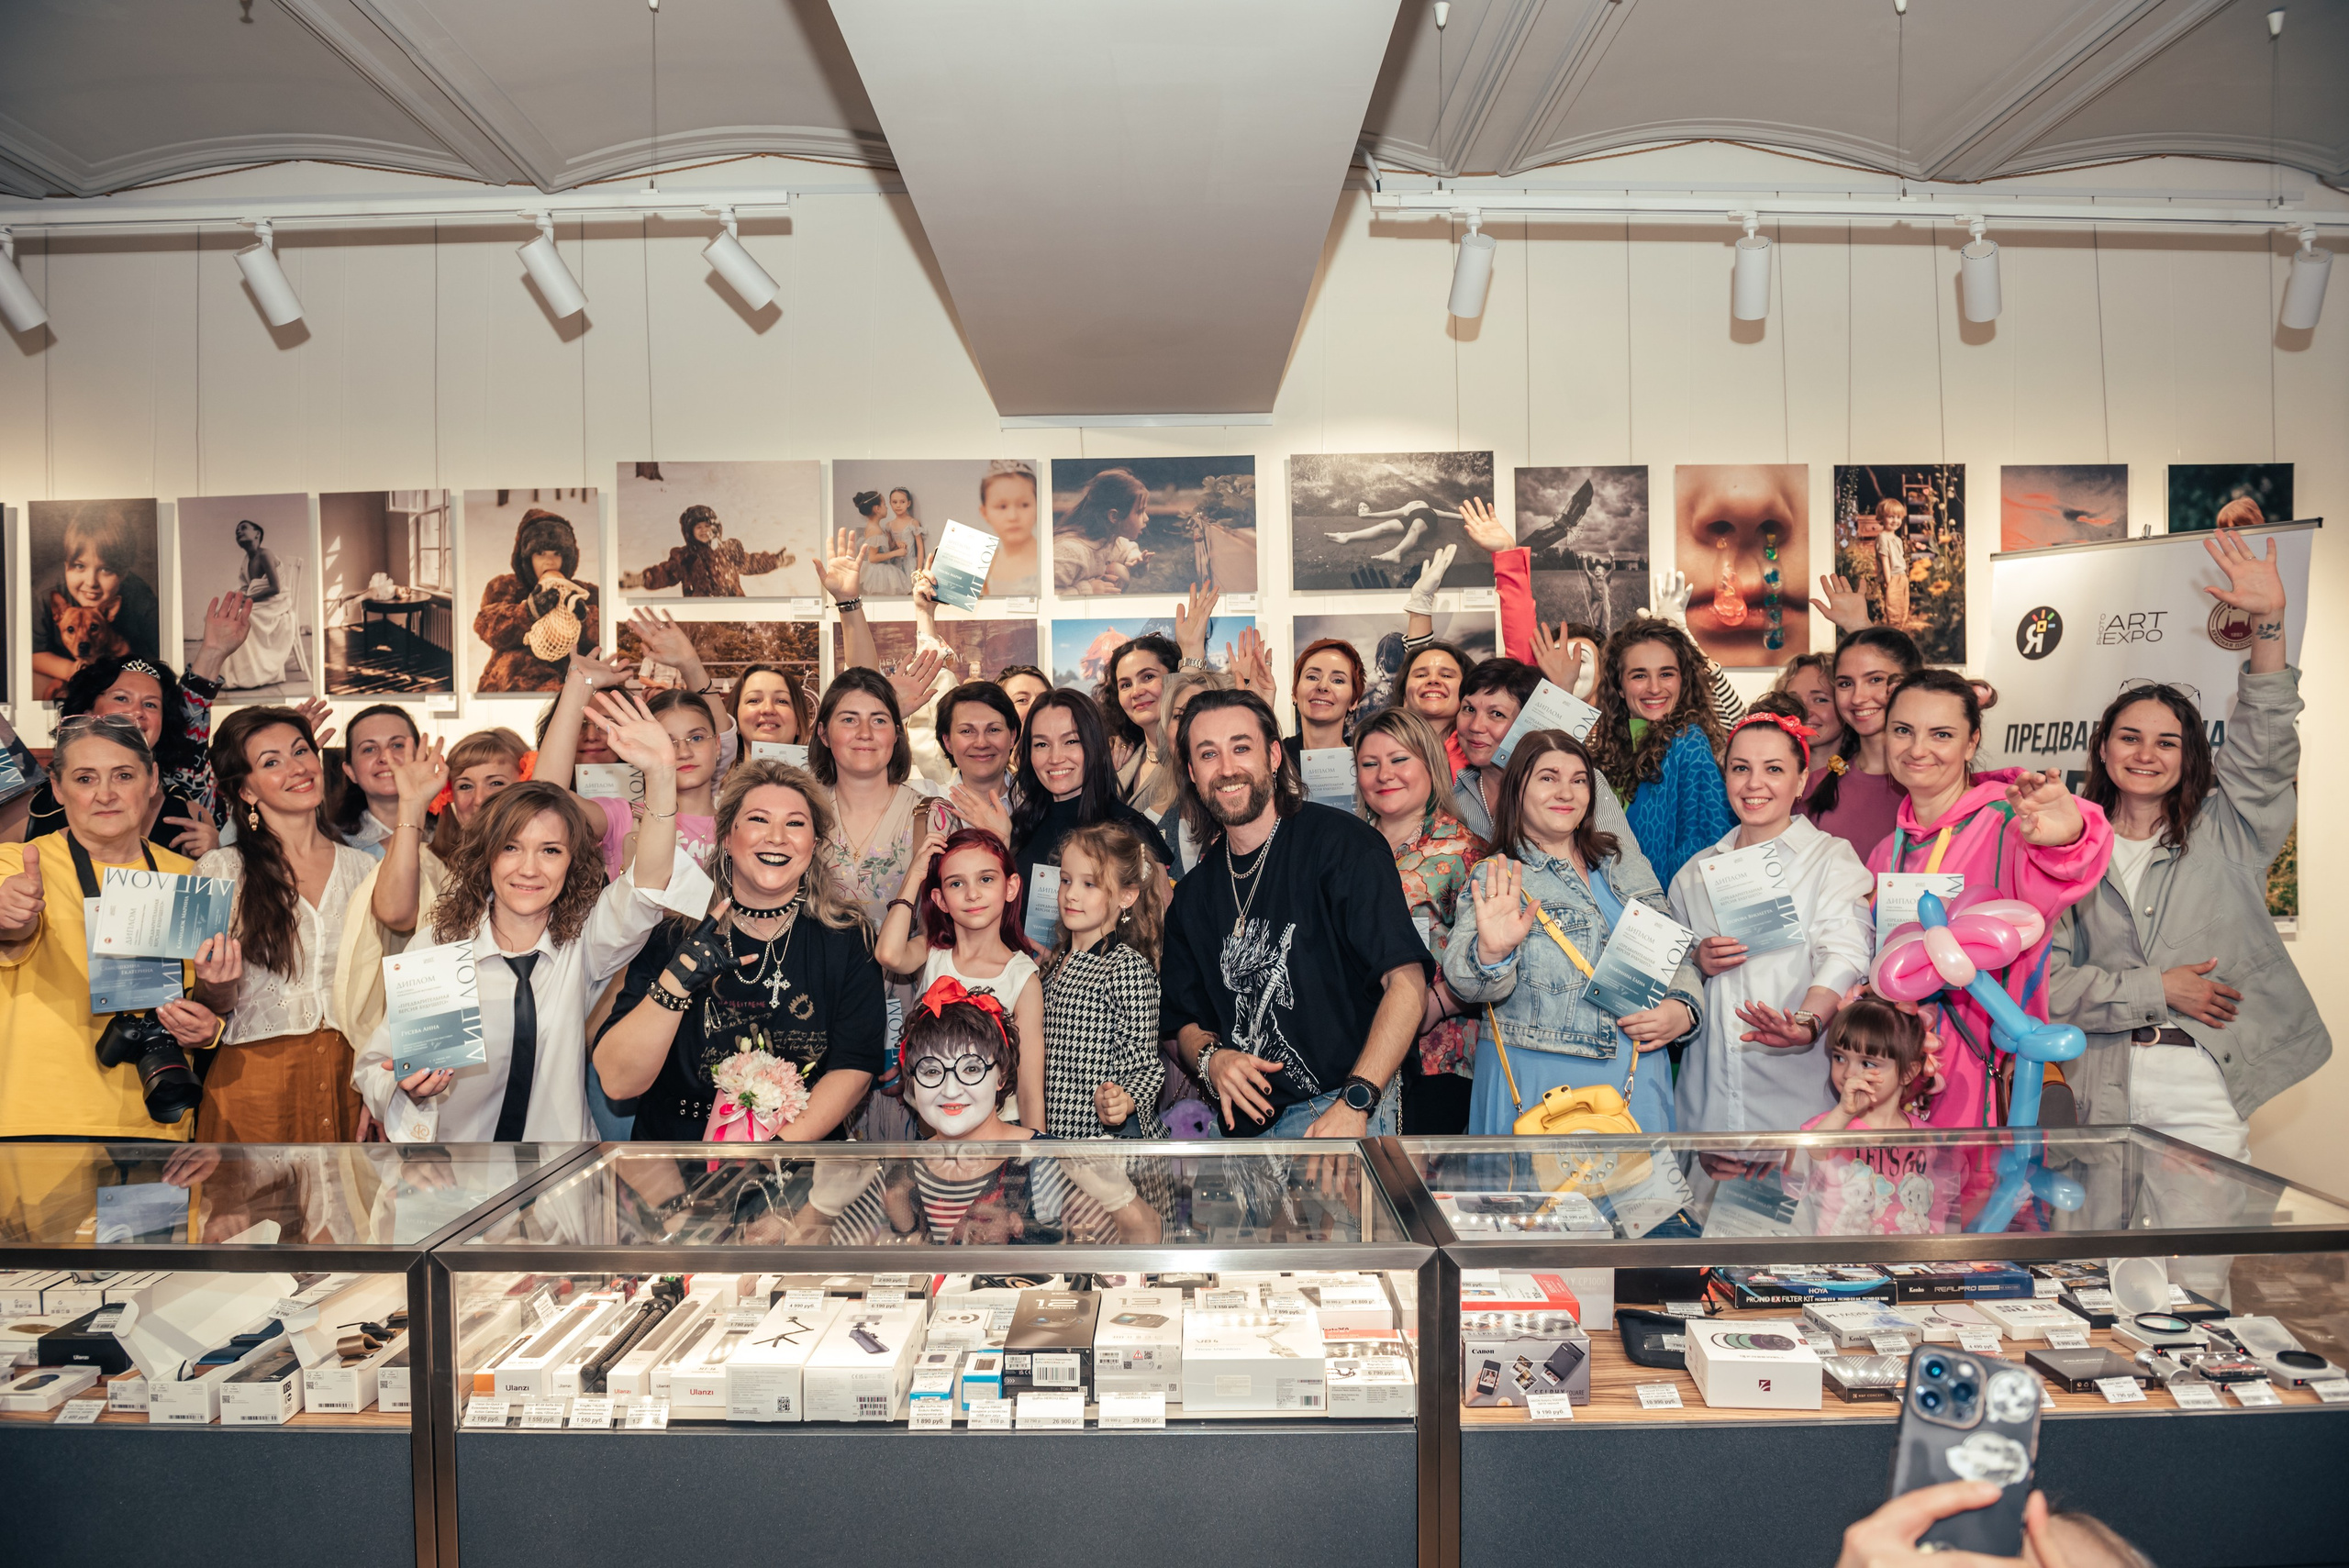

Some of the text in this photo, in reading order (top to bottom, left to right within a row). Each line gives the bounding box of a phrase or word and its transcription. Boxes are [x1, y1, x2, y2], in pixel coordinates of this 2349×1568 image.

[2106, 611, 2168, 631] ART
[2102, 629, 2164, 645] EXPO
[2211, 629, 2233, 648] КРАСНАЯ
[1534, 702, 1563, 720] ДИПЛОМ
[1714, 872, 1748, 886] ДИПЛОМ
[126, 908, 138, 946] ДИПЛОМ
[1626, 925, 1655, 944] ДИПЛОМ
[1642, 929, 1694, 1010] ИПЛОМ
[396, 975, 436, 990] ДИПЛОМ
[1035, 1299, 1079, 1307] 12
[1119, 1297, 1162, 1306] 13
